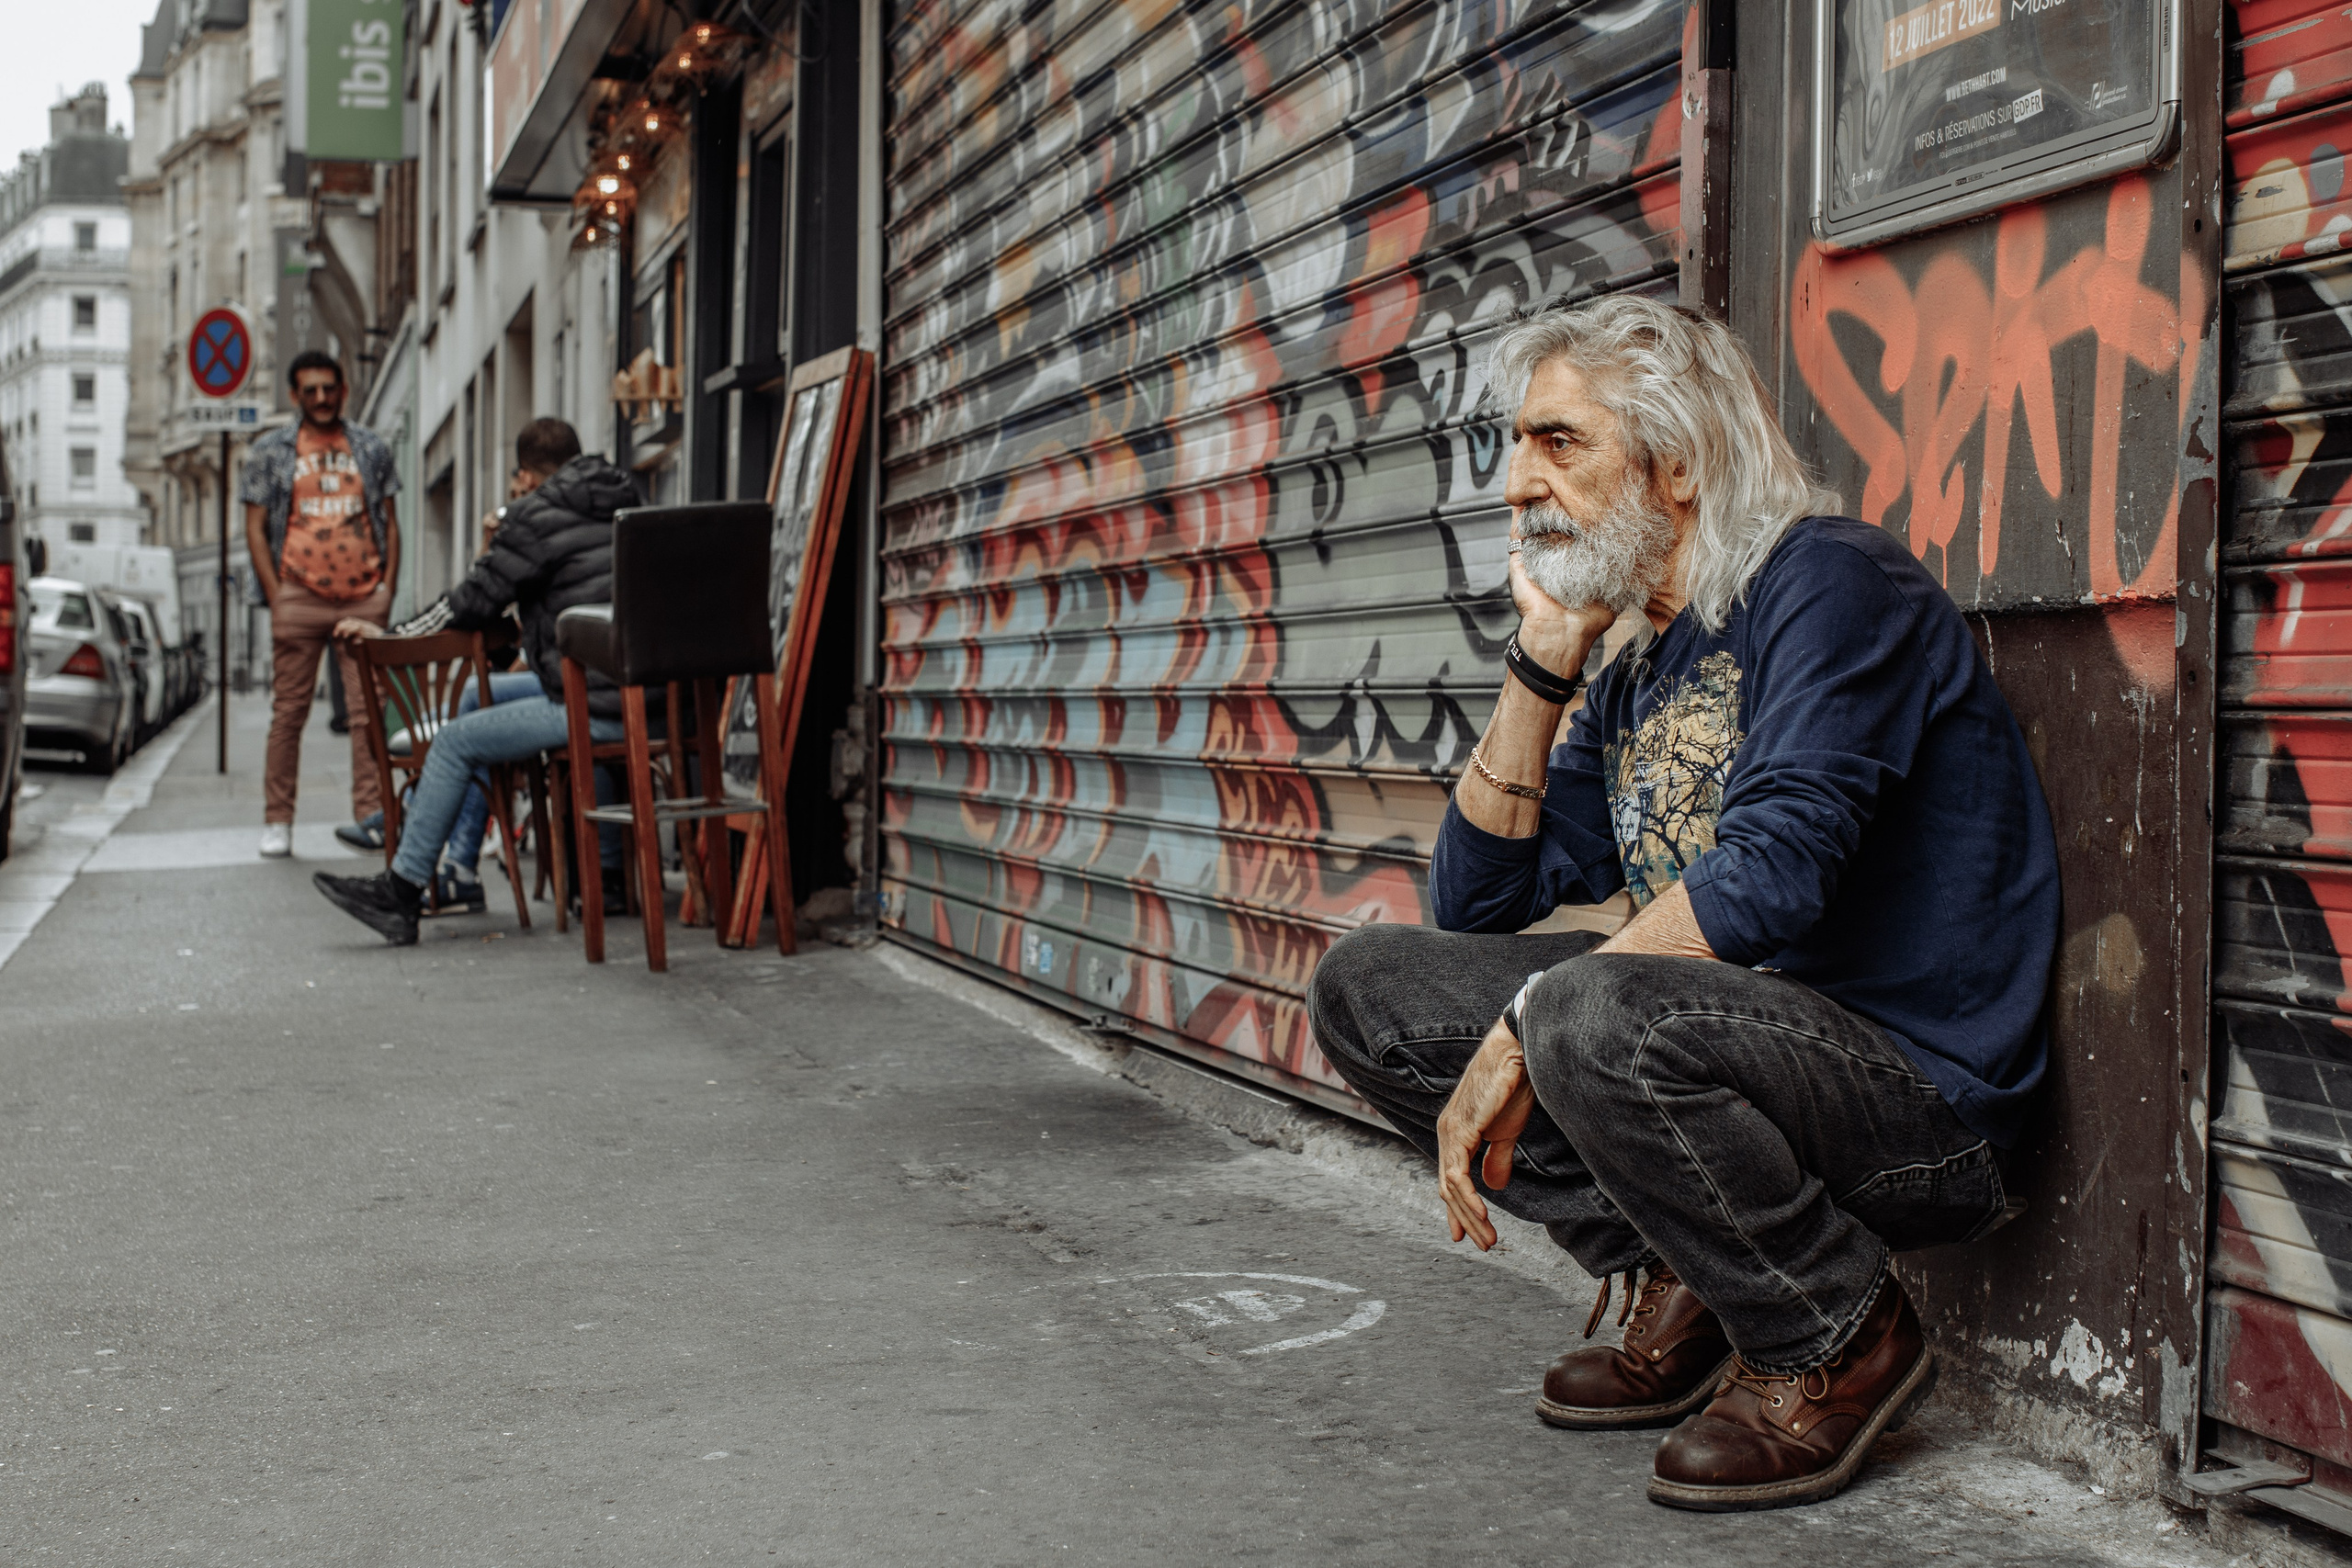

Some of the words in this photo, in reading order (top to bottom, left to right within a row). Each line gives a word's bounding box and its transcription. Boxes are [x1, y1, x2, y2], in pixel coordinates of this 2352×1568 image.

[1889, 24, 1904, 61] 12
[1905, 3, 1956, 53] JUILLET
[1958, 0, 1995, 31] 2022
[338, 18, 391, 109] ibis
[1946, 66, 2007, 102] WWW.BETHHART.COM
[1915, 130, 1936, 152] INFOS
[1937, 128, 1944, 144] &
[1944, 110, 1996, 142] RÉSERVATIONS
[1997, 104, 2013, 125] SUR
[2014, 95, 2041, 118] GDP.FR
[324, 451, 359, 475] LOS
[1510, 643, 1522, 662] TEL
